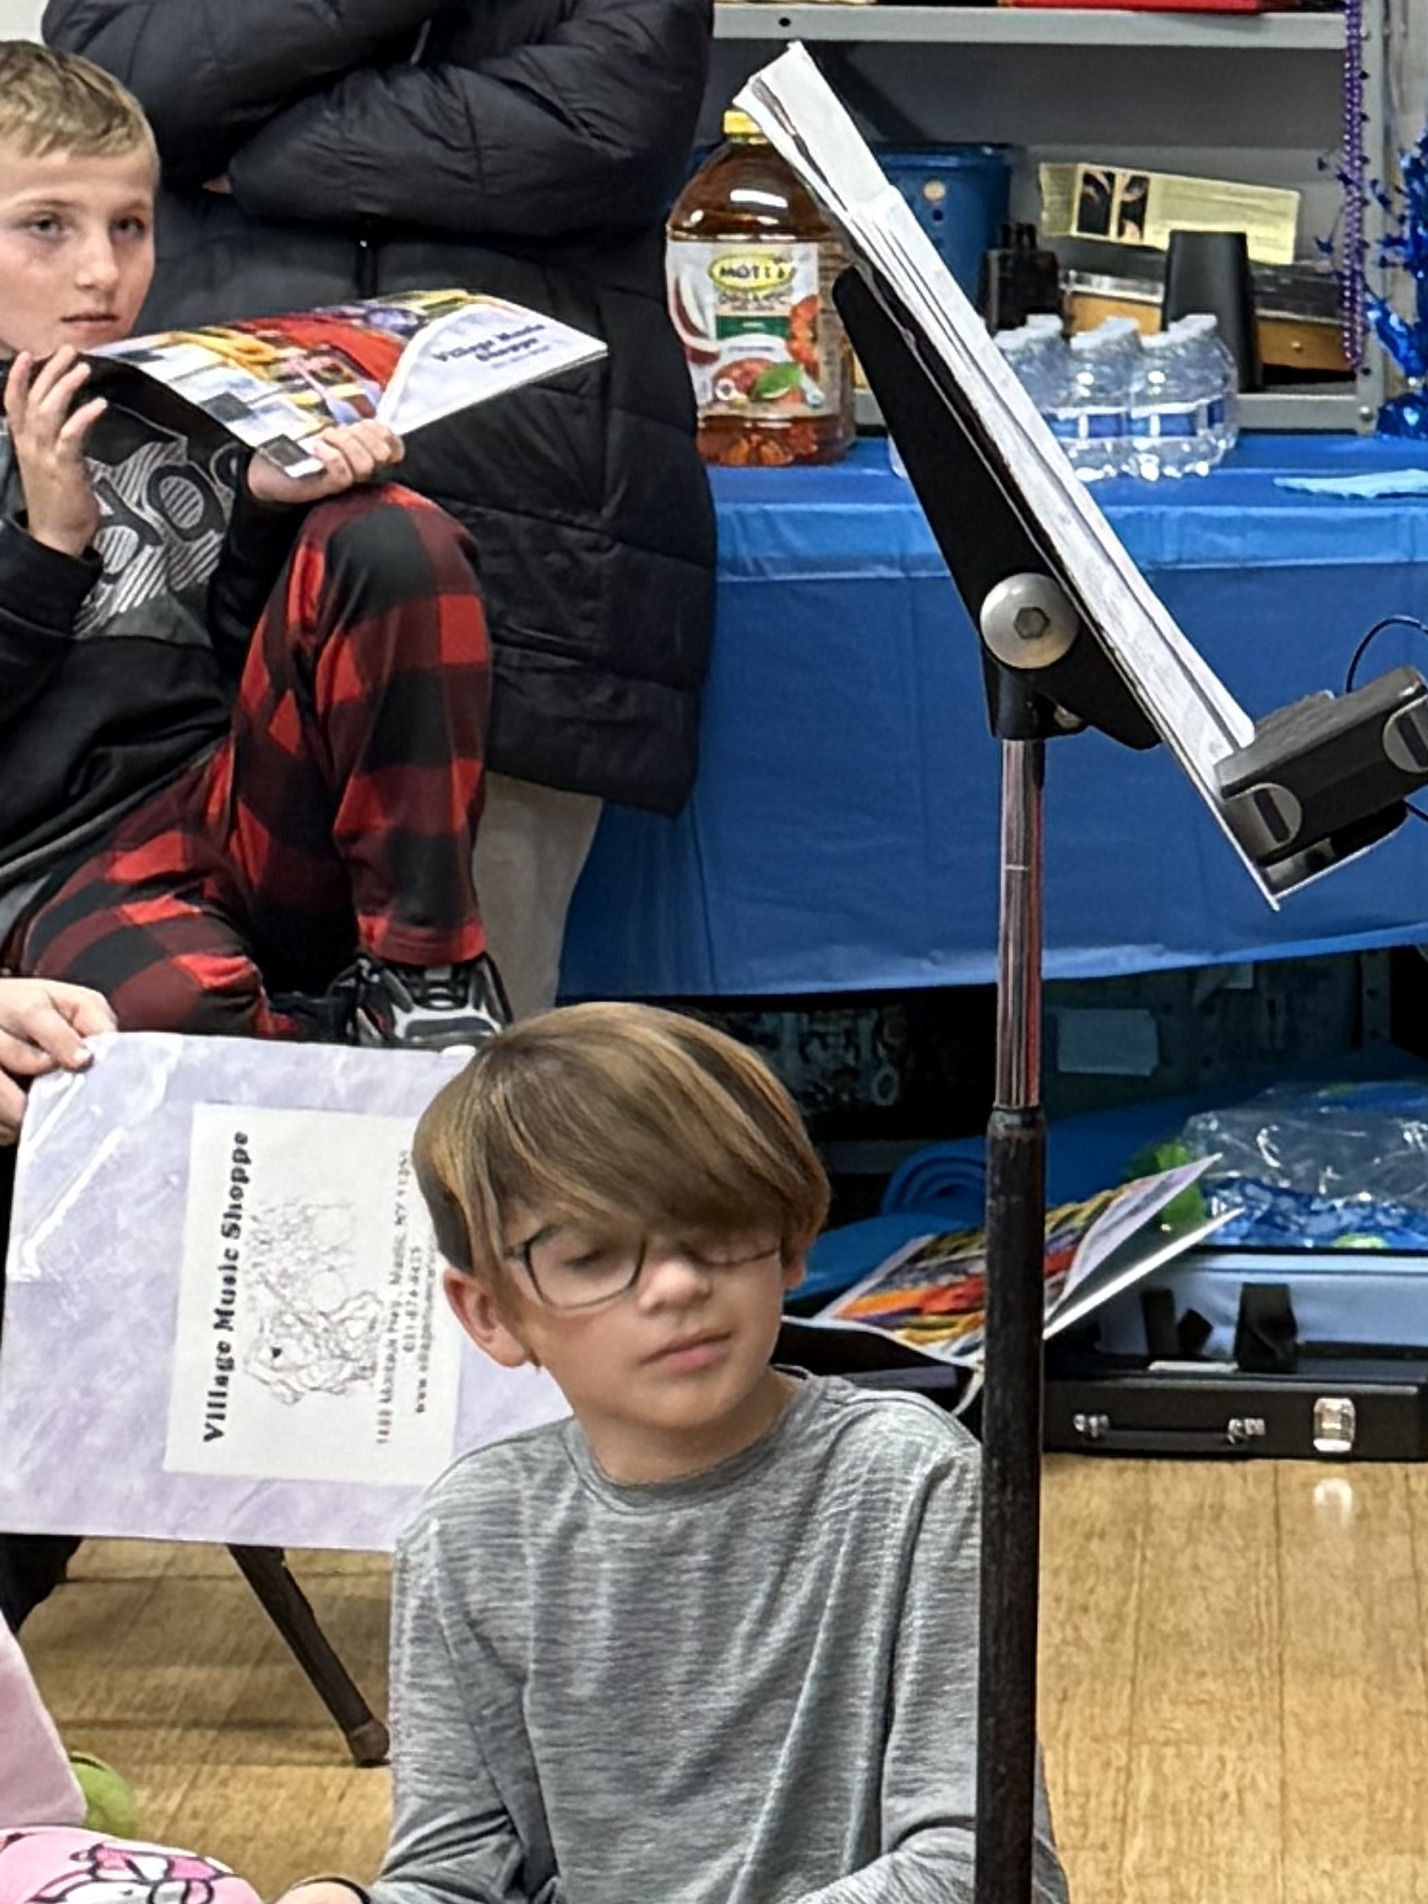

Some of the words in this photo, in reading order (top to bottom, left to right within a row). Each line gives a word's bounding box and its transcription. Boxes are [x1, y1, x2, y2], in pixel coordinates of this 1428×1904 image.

[219, 1130, 252, 1240] Shoppe
[212, 1248, 240, 1332] Music
[202, 1340, 234, 1442] Village
